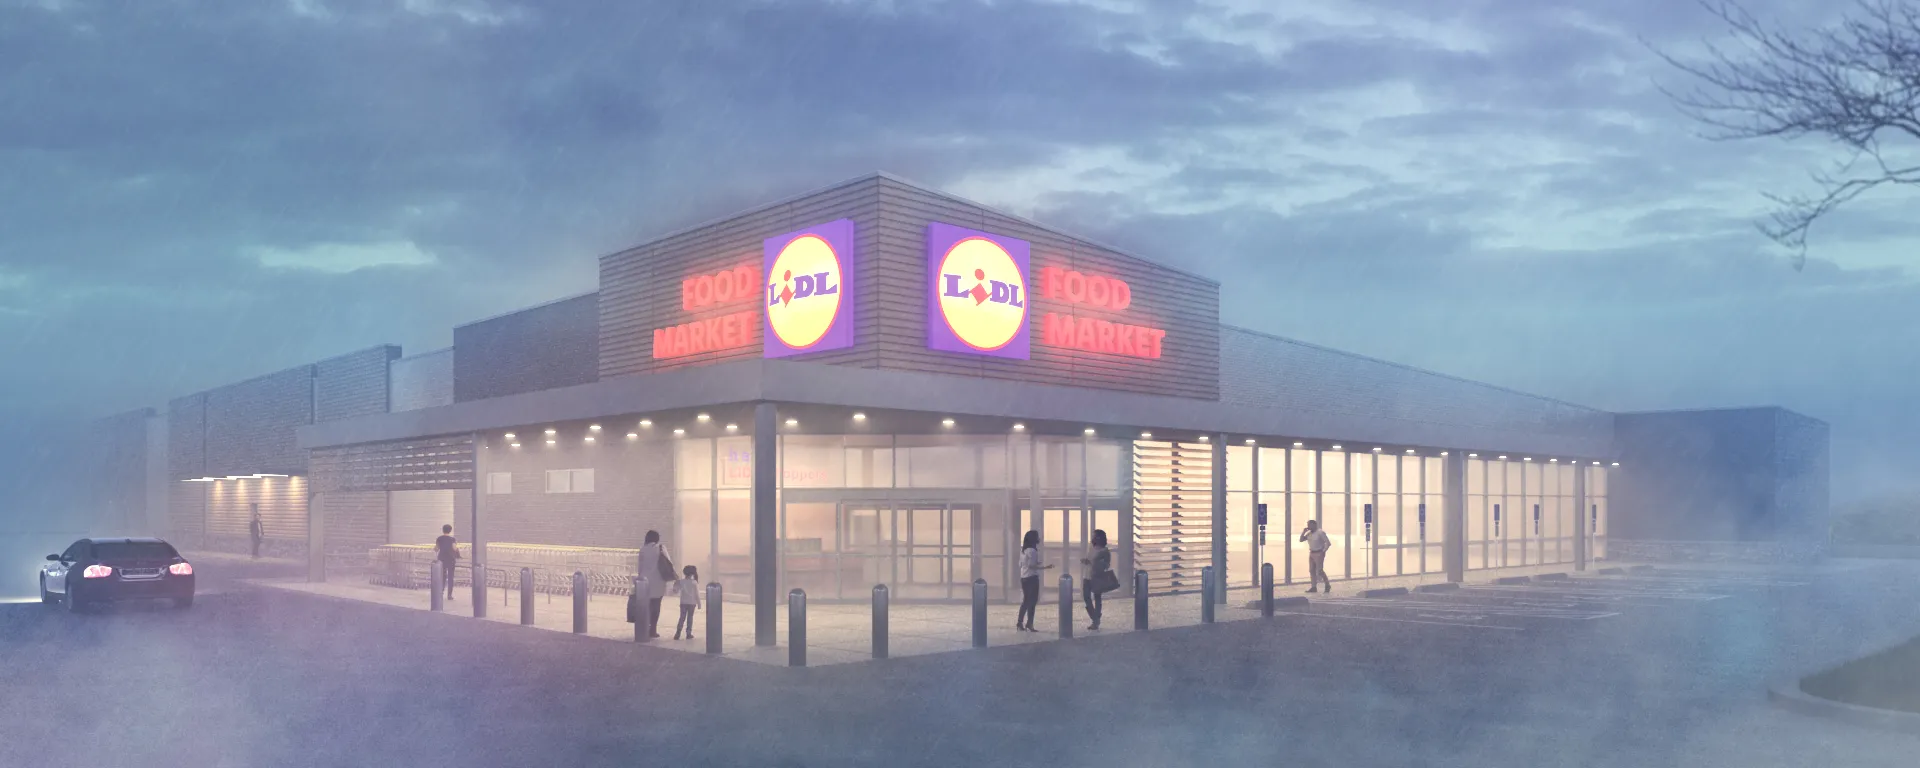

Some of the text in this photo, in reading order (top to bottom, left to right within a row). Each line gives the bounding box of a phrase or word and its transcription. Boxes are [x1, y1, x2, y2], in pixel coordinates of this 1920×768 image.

[682, 265, 760, 311] FOOD
[1042, 266, 1131, 310] FOOD
[653, 311, 757, 358] MARKET
[1043, 312, 1166, 358] MARKET
